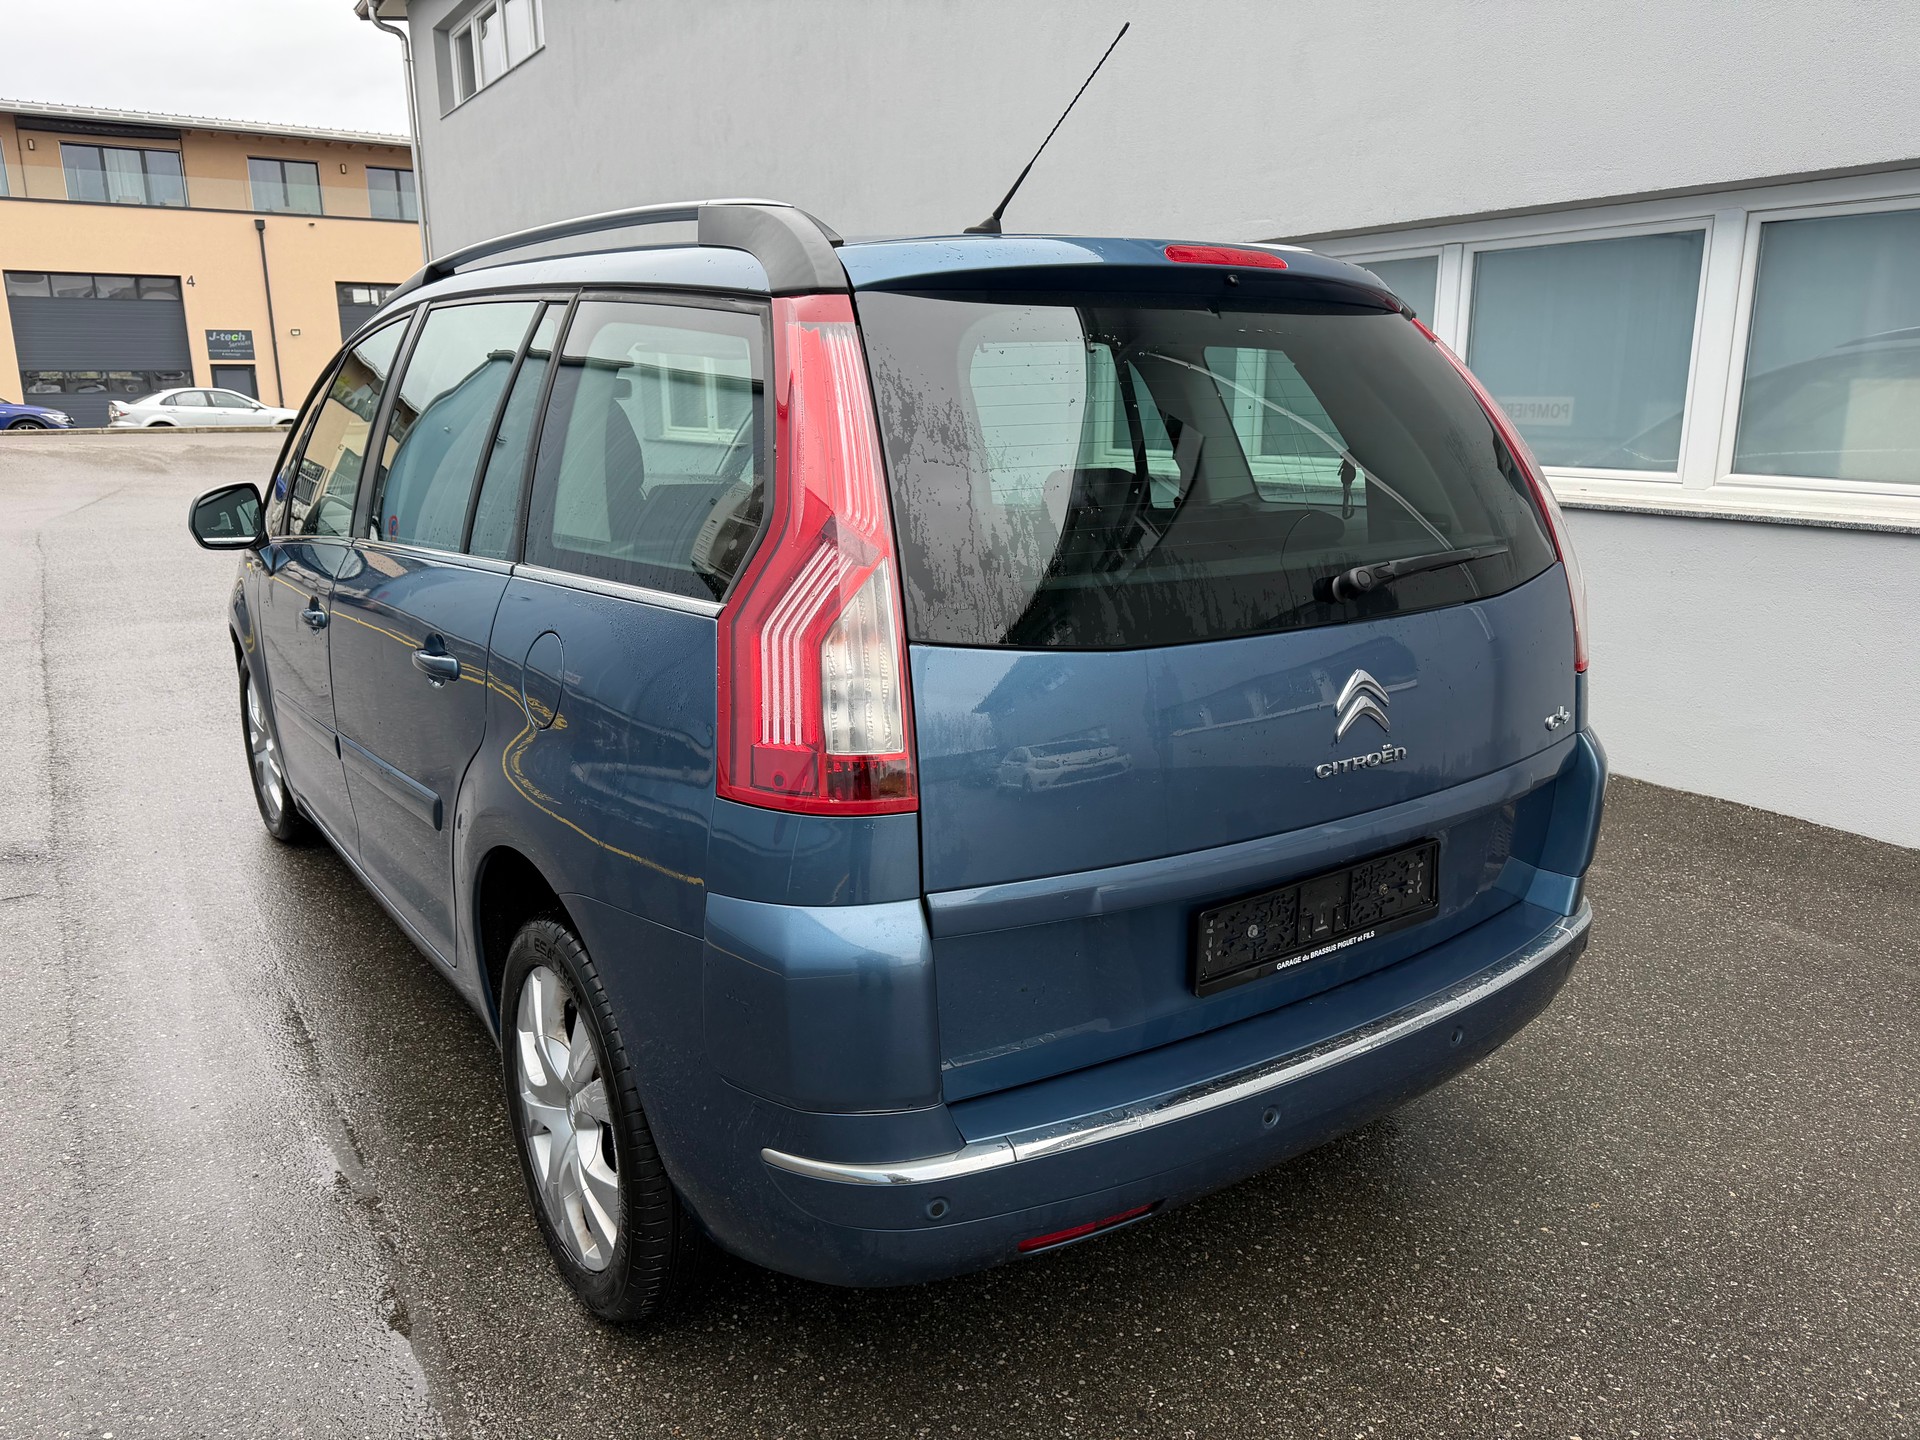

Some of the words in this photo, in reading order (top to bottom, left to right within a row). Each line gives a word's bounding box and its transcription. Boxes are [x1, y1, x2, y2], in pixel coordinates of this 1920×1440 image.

[186, 275, 196, 287] 4
[208, 332, 246, 341] J-tech
[1276, 956, 1302, 970] GARAGE
[1302, 954, 1310, 962] du
[1310, 944, 1337, 959] BRASSUS
[1337, 936, 1358, 950] PIGUET
[1357, 934, 1363, 942] et
[1363, 930, 1375, 940] FILS
